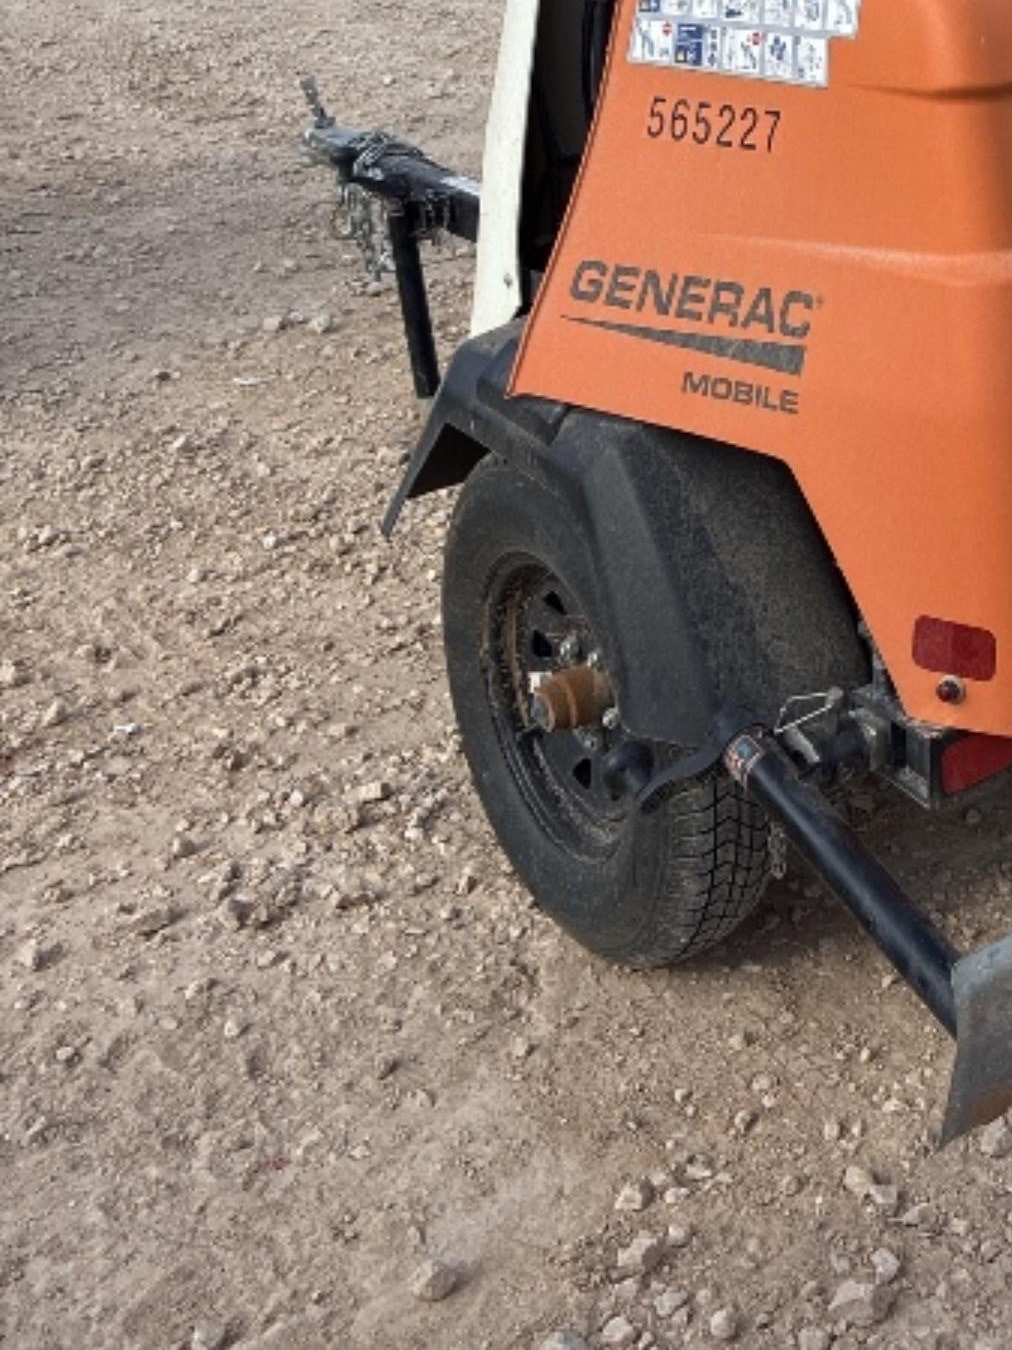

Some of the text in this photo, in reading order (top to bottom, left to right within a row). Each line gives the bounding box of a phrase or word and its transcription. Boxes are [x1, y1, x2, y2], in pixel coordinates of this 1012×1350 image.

[647, 95, 781, 154] 565227
[569, 260, 816, 338] GENERAC
[681, 371, 800, 415] MOBILE
